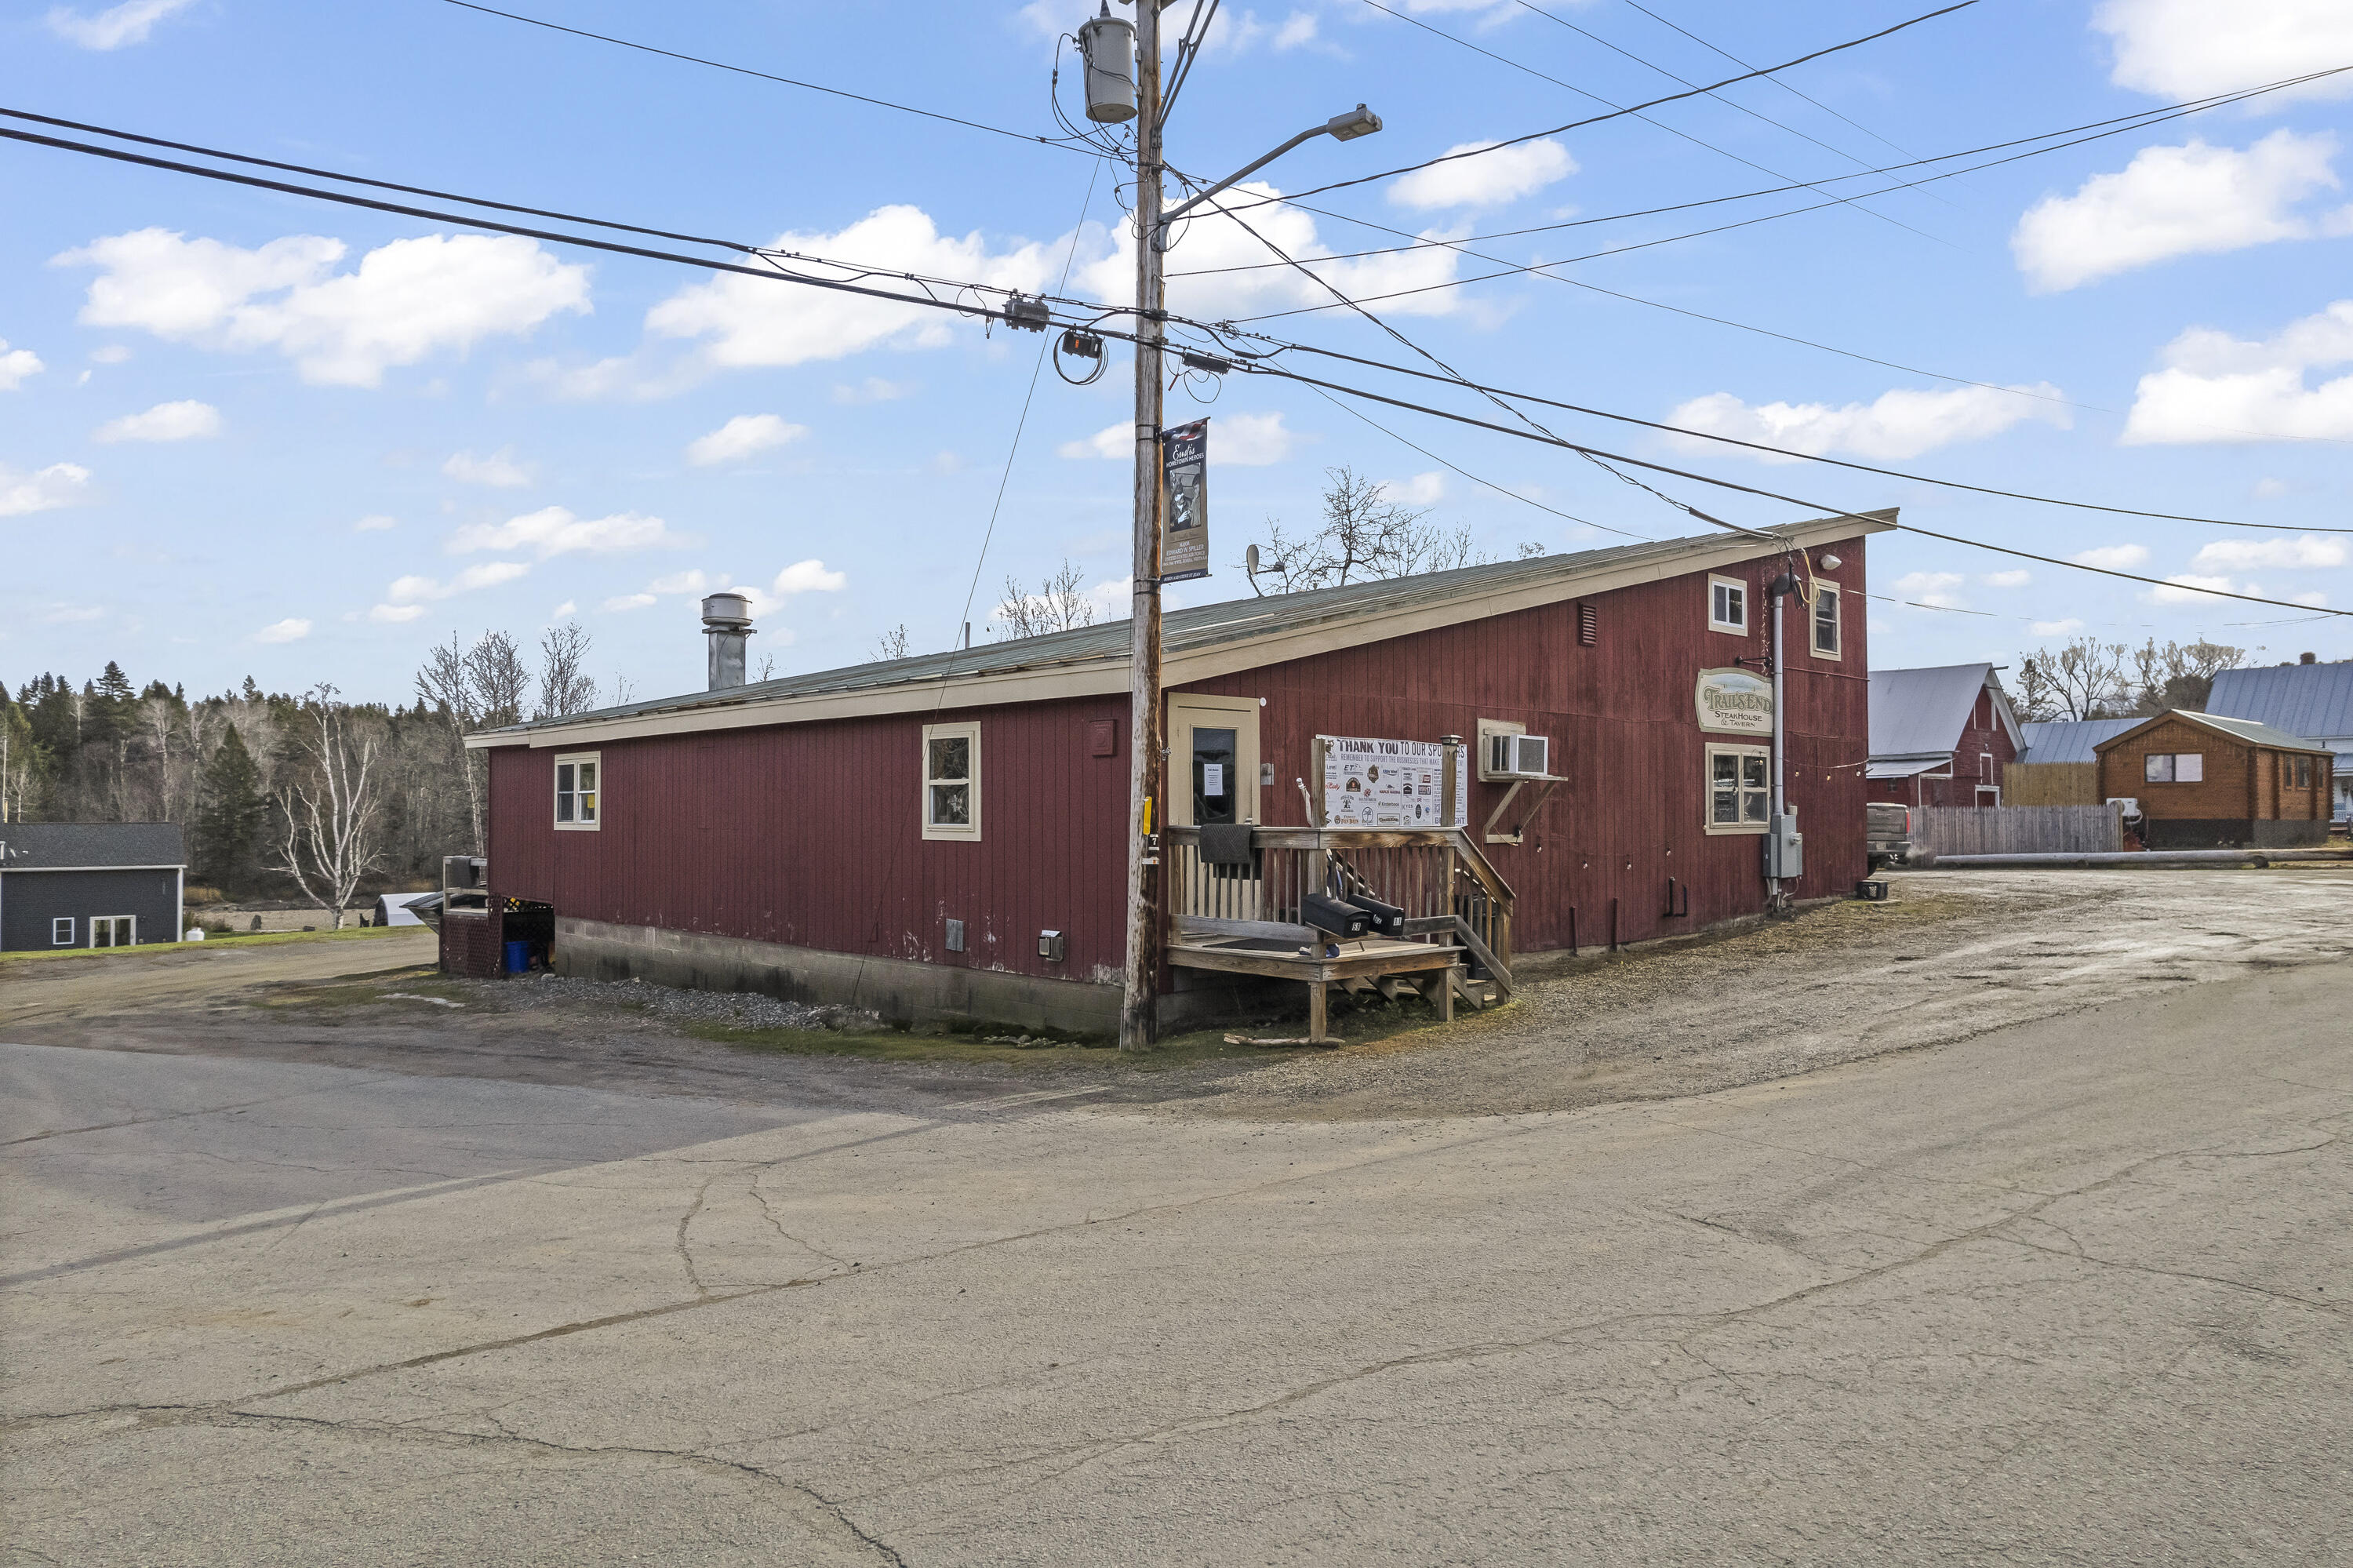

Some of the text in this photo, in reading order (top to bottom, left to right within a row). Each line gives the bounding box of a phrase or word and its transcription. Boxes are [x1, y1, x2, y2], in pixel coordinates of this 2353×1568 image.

[1173, 443, 1195, 460] Eustis
[1166, 453, 1204, 467] HOMETOWN HEROES
[1337, 739, 1464, 759] THANK YOU TO OUR SPORS
[1341, 753, 1363, 762] REMEMBER
[1152, 837, 1157, 846] 7
